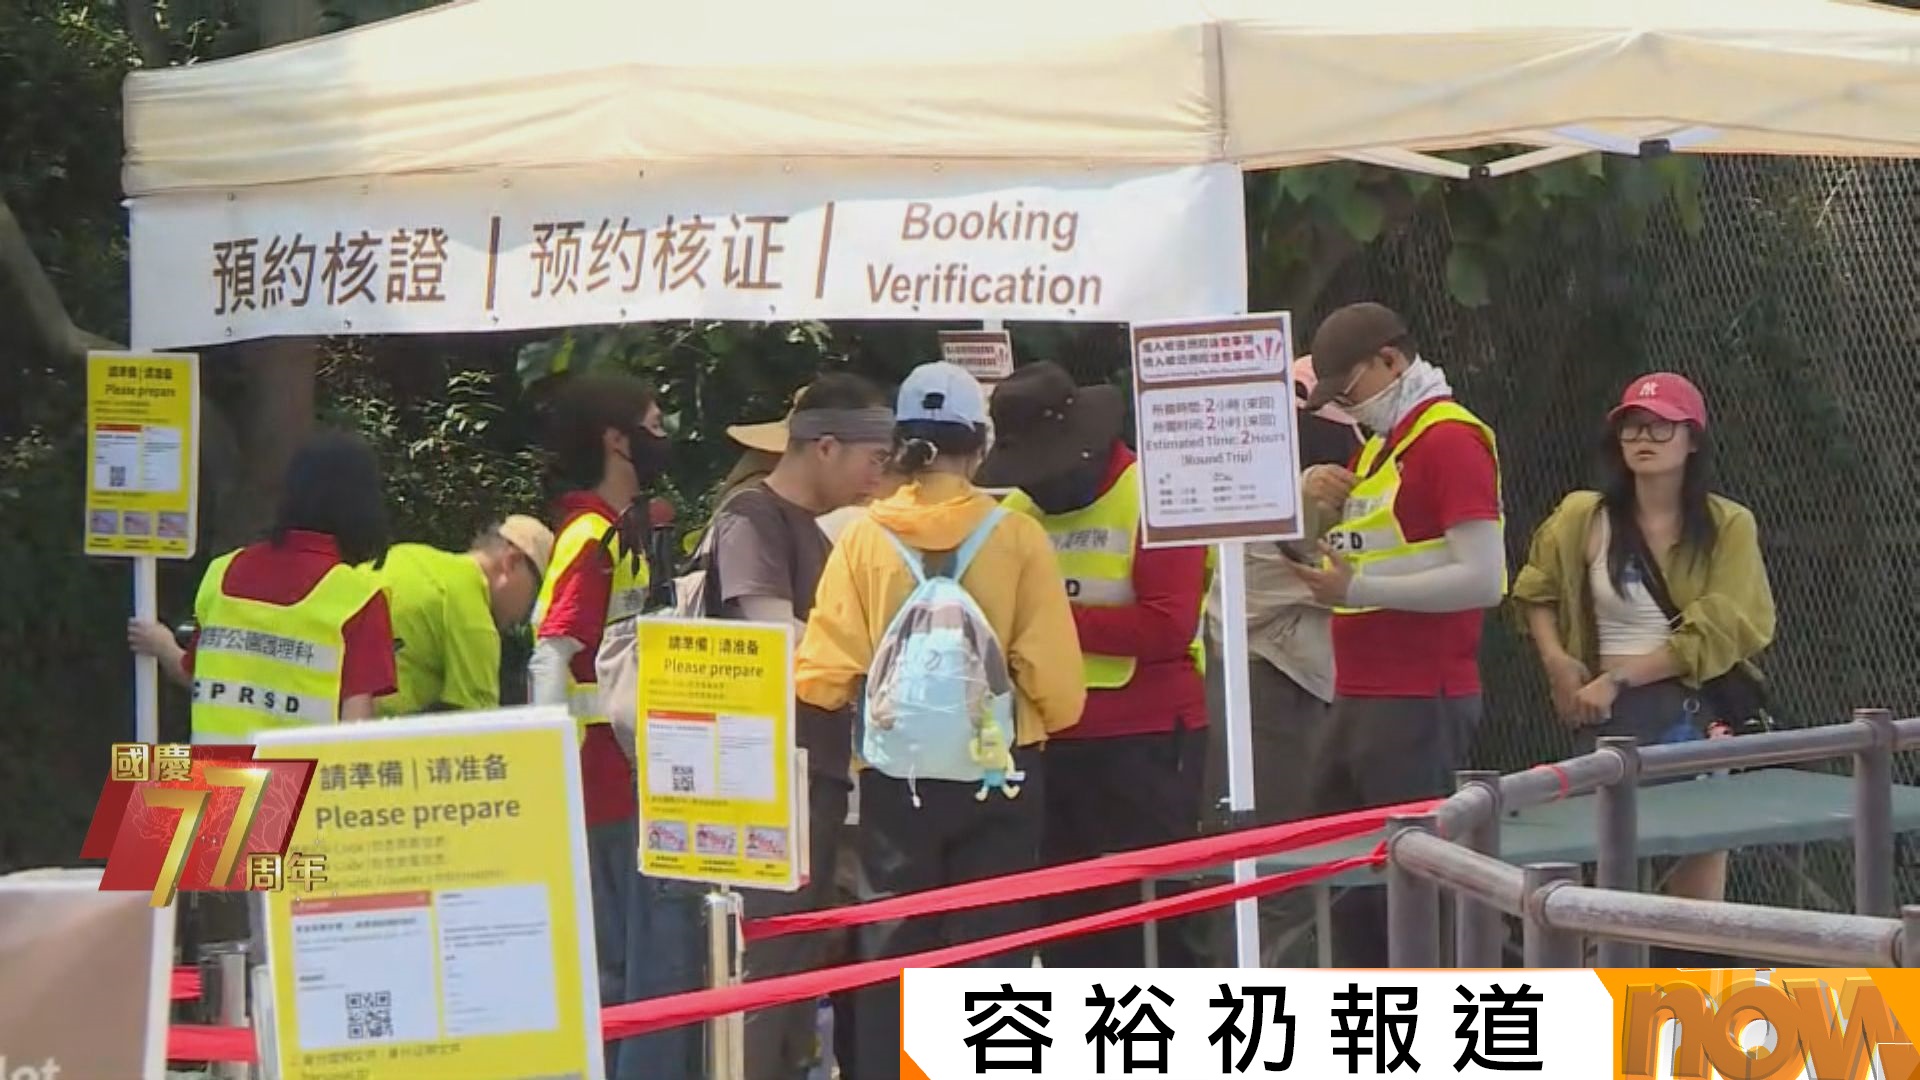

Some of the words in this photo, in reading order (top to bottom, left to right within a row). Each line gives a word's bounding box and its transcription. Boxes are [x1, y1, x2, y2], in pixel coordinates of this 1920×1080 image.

[901, 202, 1078, 250] Booking
[212, 227, 449, 315] 預約核證
[530, 214, 790, 298] 预约核证
[867, 263, 1102, 307] Verification
[105, 384, 136, 397] Please
[138, 387, 176, 398] prepare
[1146, 436, 1204, 451] Estimated
[664, 658, 707, 674] Please
[710, 663, 764, 680] prepare
[319, 760, 404, 791] 請準備
[427, 753, 508, 784] 请准备
[315, 804, 405, 830] Please
[413, 799, 521, 829] prepare
